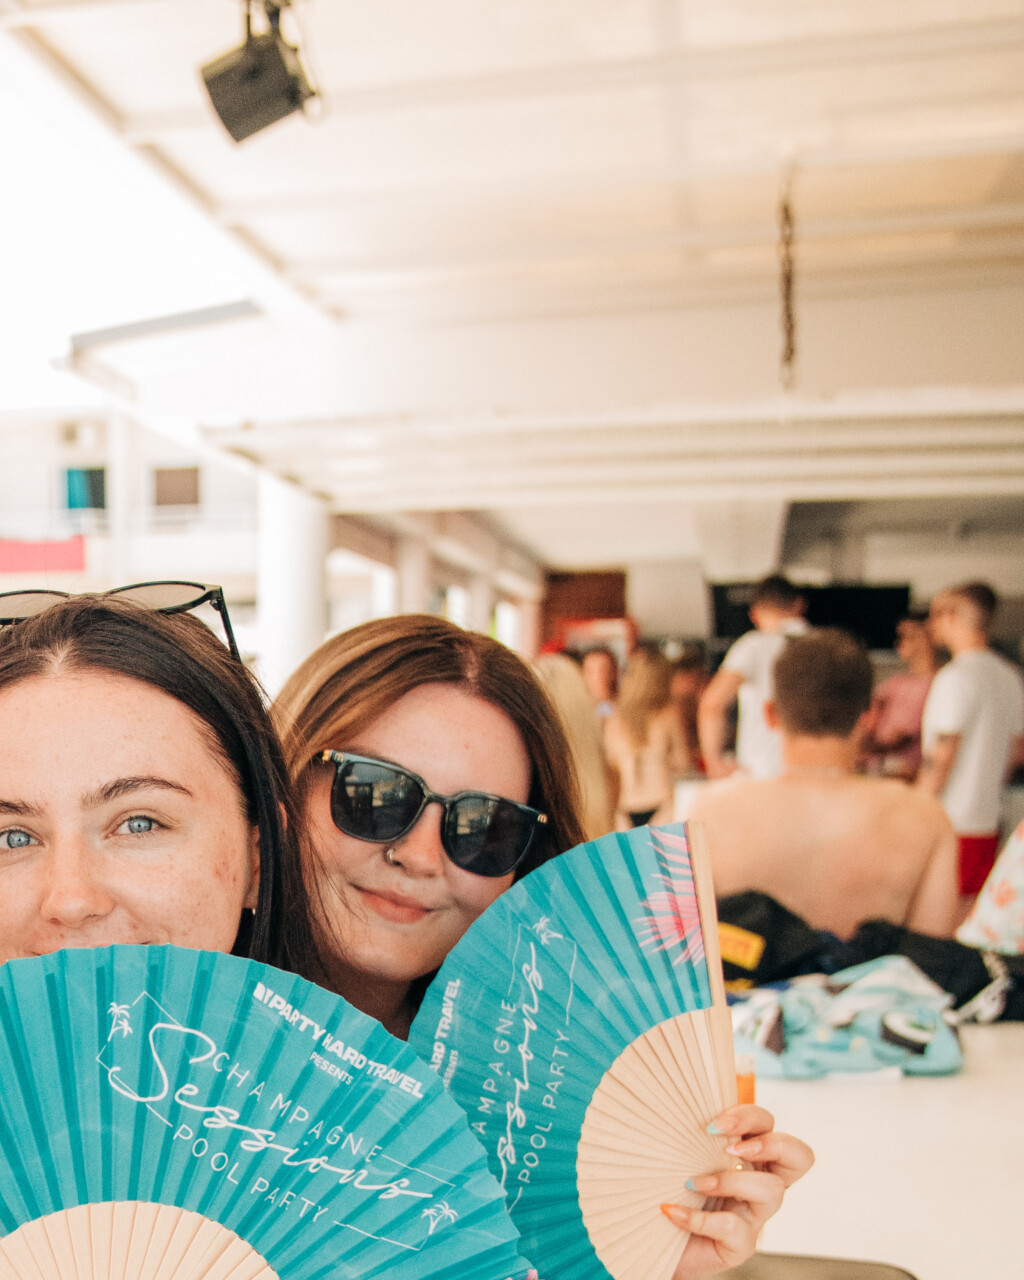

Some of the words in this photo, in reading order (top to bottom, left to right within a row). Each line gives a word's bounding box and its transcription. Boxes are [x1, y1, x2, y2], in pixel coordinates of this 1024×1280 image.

[267, 994, 327, 1041] PARTY
[322, 1033, 367, 1070] HARD
[366, 1060, 425, 1099] TRAVEL
[429, 1041, 446, 1073] ARD
[434, 979, 461, 1039] TRAVEL
[108, 1022, 433, 1200] Sessions
[213, 1052, 383, 1163] CHAMPAGNE
[309, 1051, 354, 1085] PESENTS
[471, 998, 516, 1135] AMPAGNE
[497, 941, 543, 1188] ssions
[517, 1121, 553, 1184] POOL
[542, 1029, 570, 1110] PARTY
[173, 1123, 240, 1185] POOL
[250, 1176, 329, 1223] PARTY
